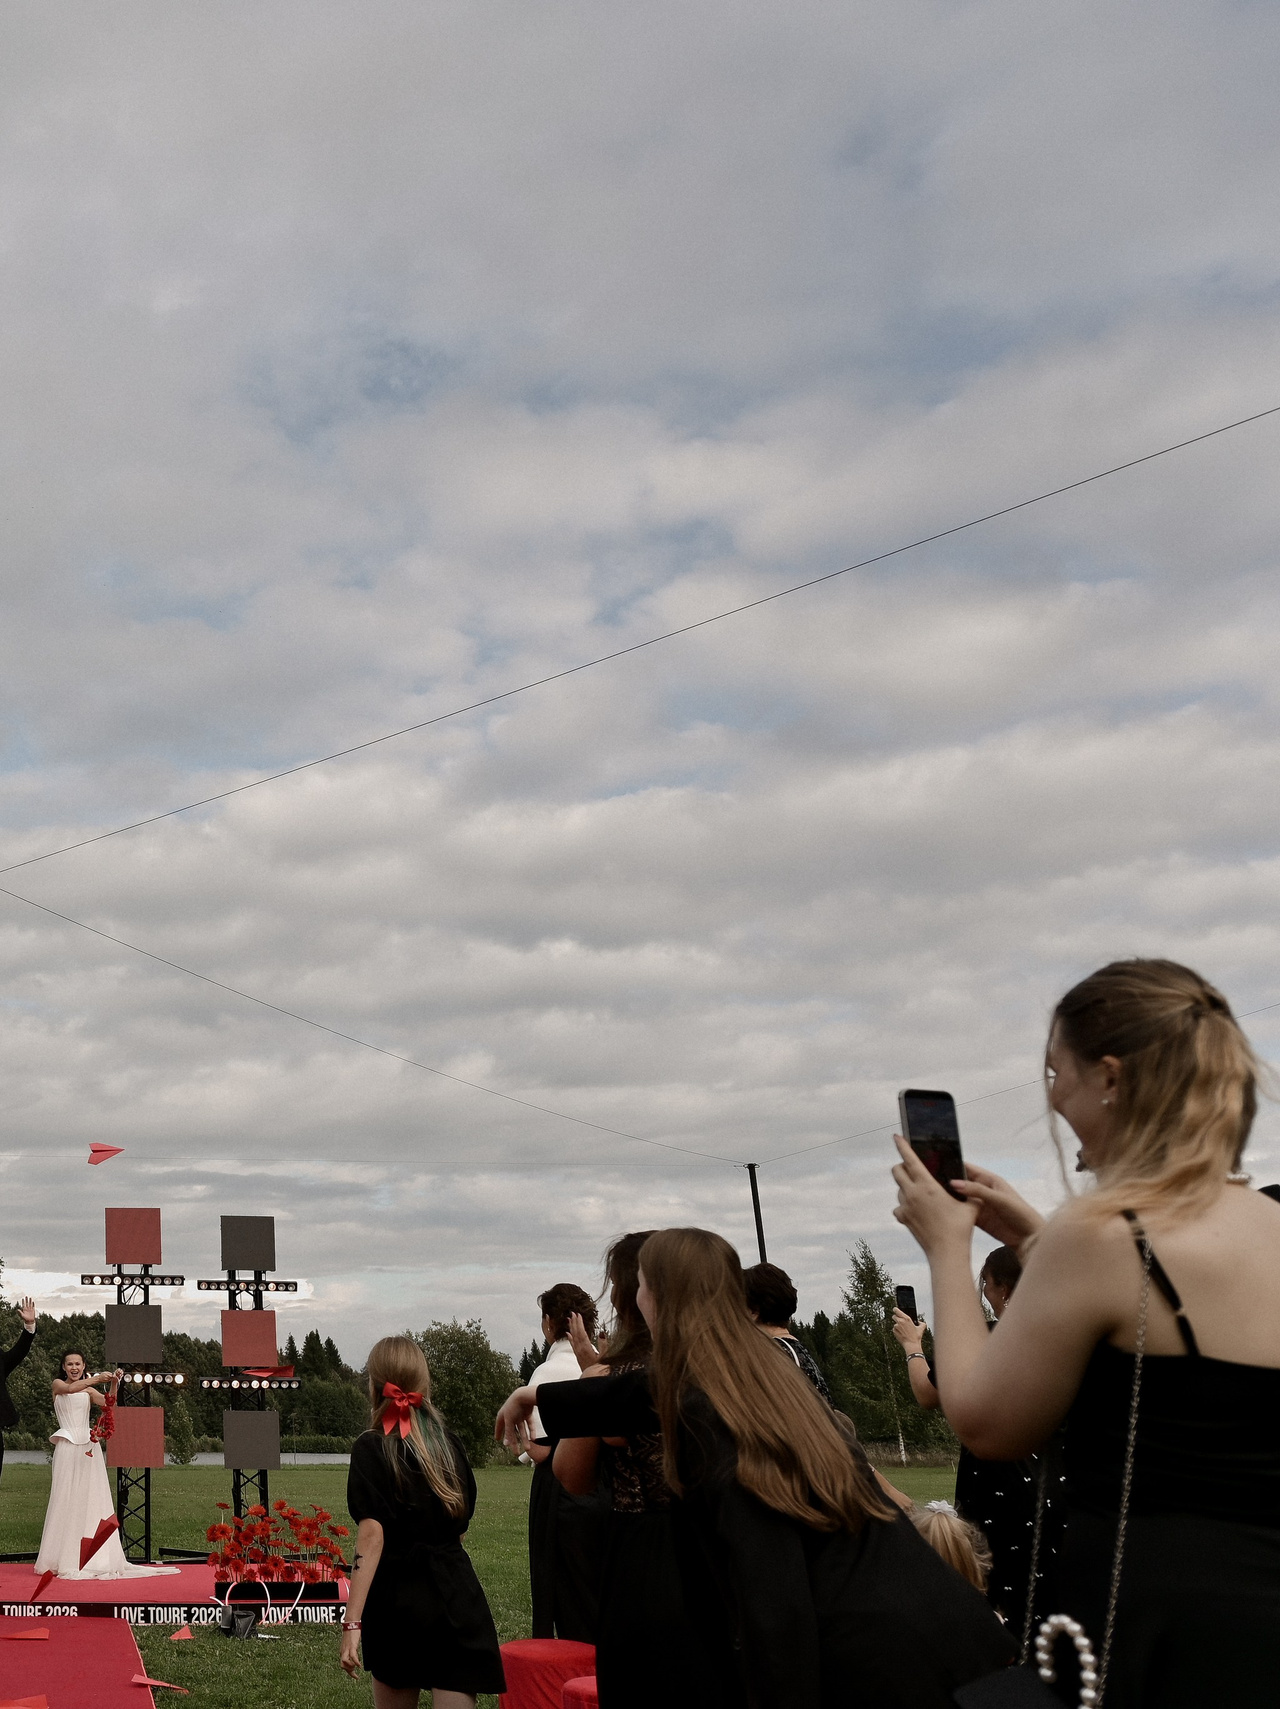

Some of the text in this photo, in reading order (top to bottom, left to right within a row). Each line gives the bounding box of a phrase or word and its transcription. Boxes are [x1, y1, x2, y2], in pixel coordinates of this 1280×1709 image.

[2, 1604, 42, 1617] TOURE
[113, 1606, 222, 1624] LOVE TOURE 2026
[261, 1606, 294, 1625] LOVE
[295, 1606, 336, 1624] TOURE
